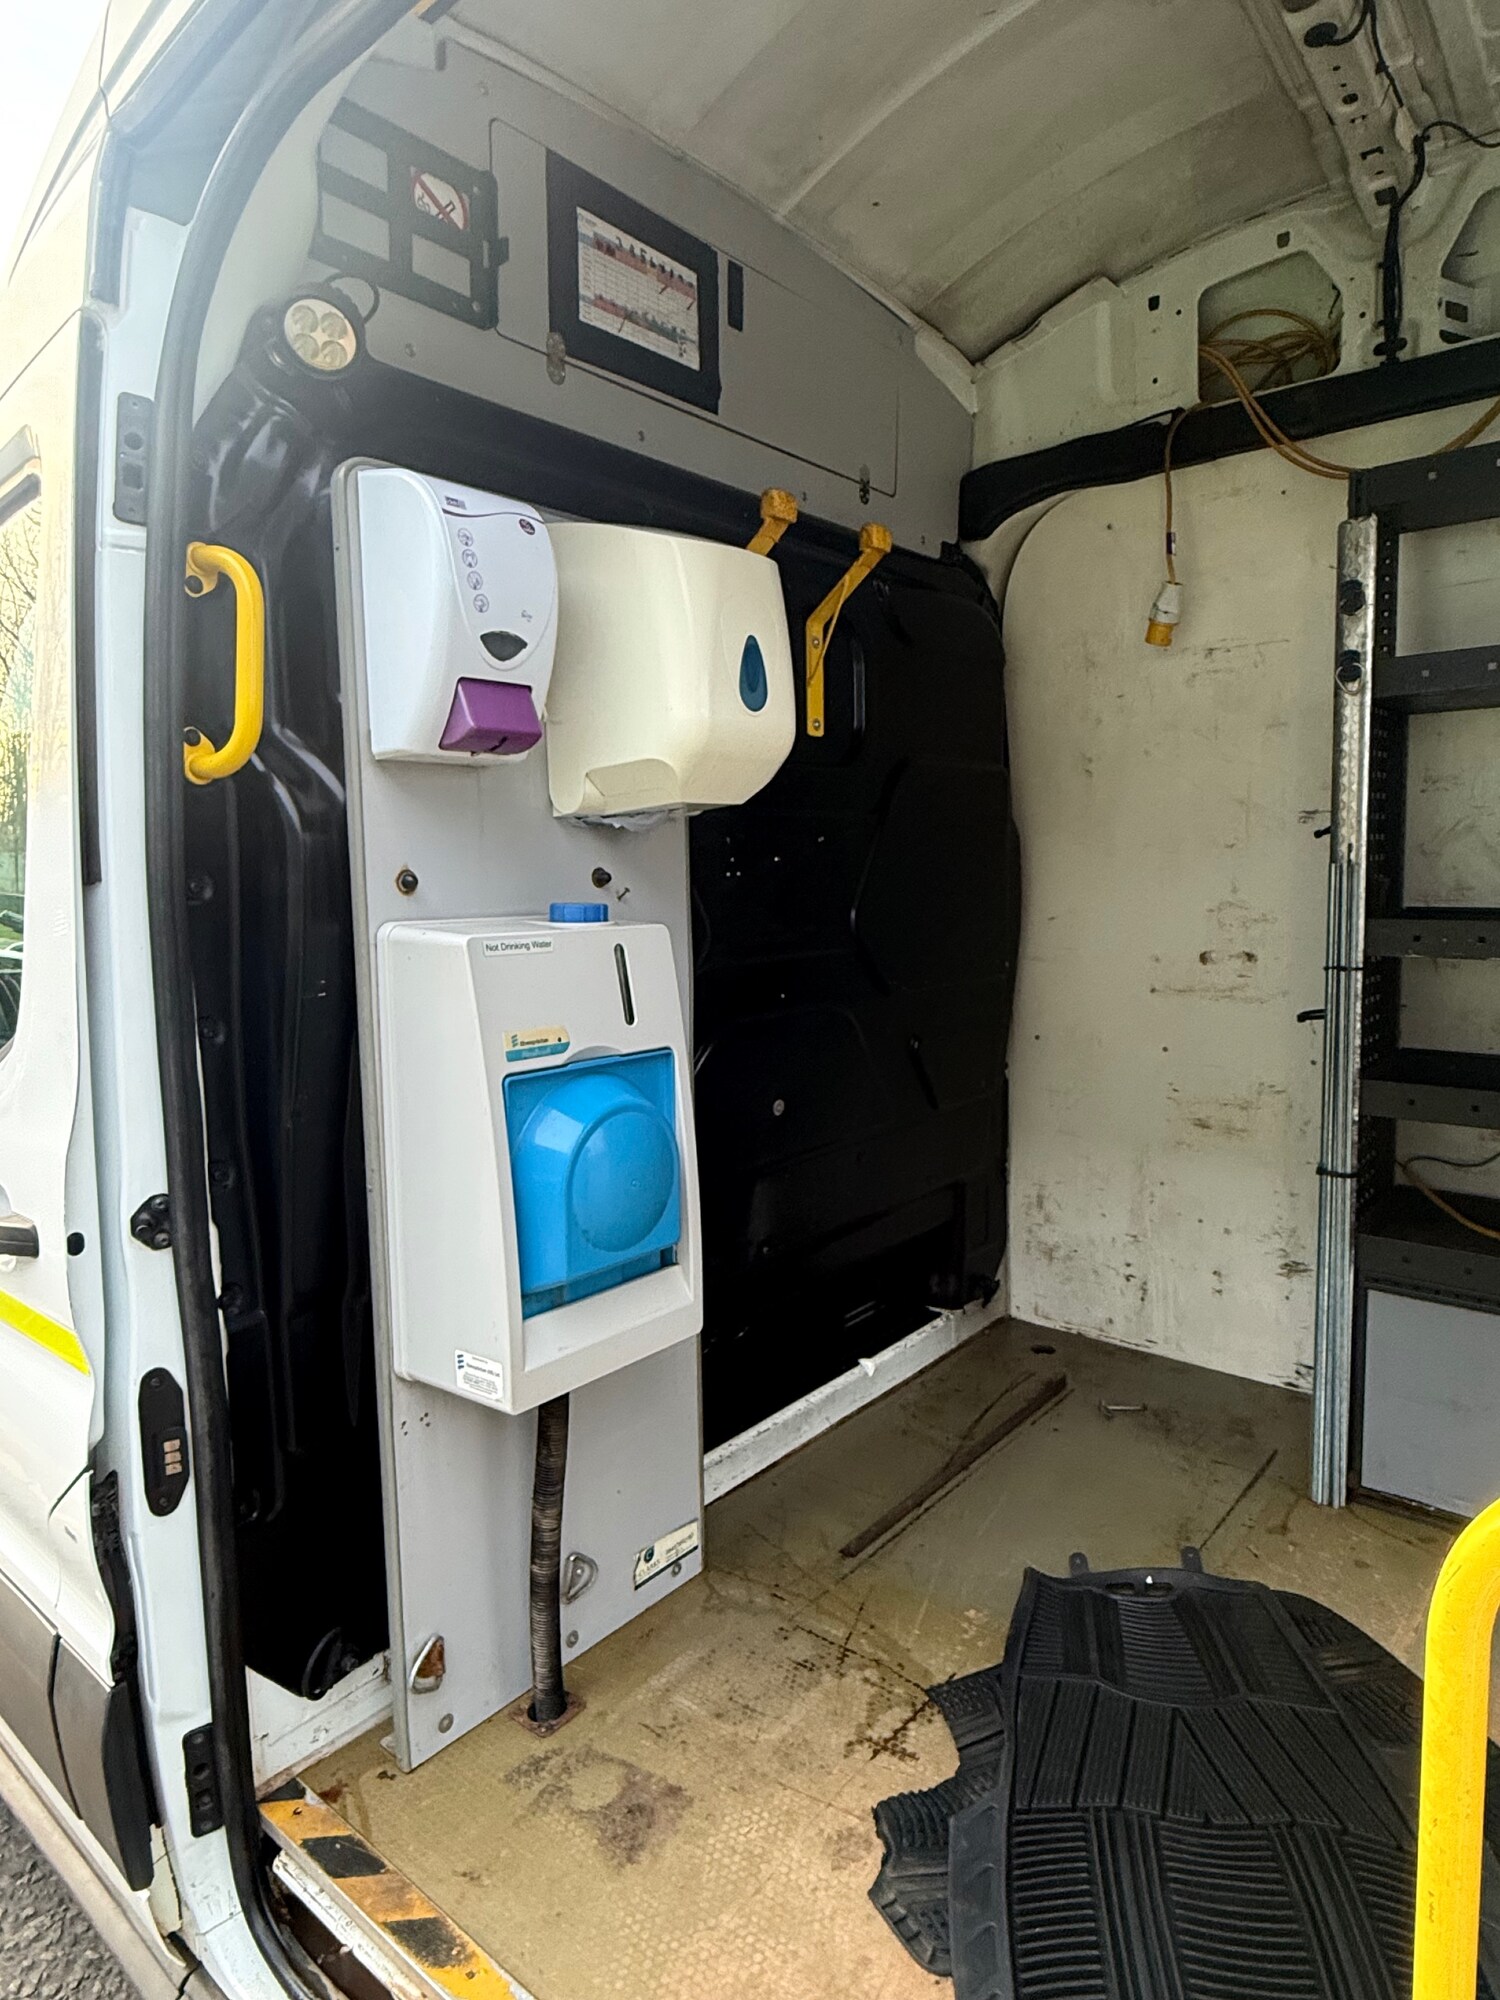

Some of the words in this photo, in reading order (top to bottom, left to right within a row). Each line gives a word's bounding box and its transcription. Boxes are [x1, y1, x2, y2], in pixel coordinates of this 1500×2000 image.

[485, 943, 500, 952] Not
[500, 942, 531, 952] Drinking
[531, 941, 552, 949] Water
